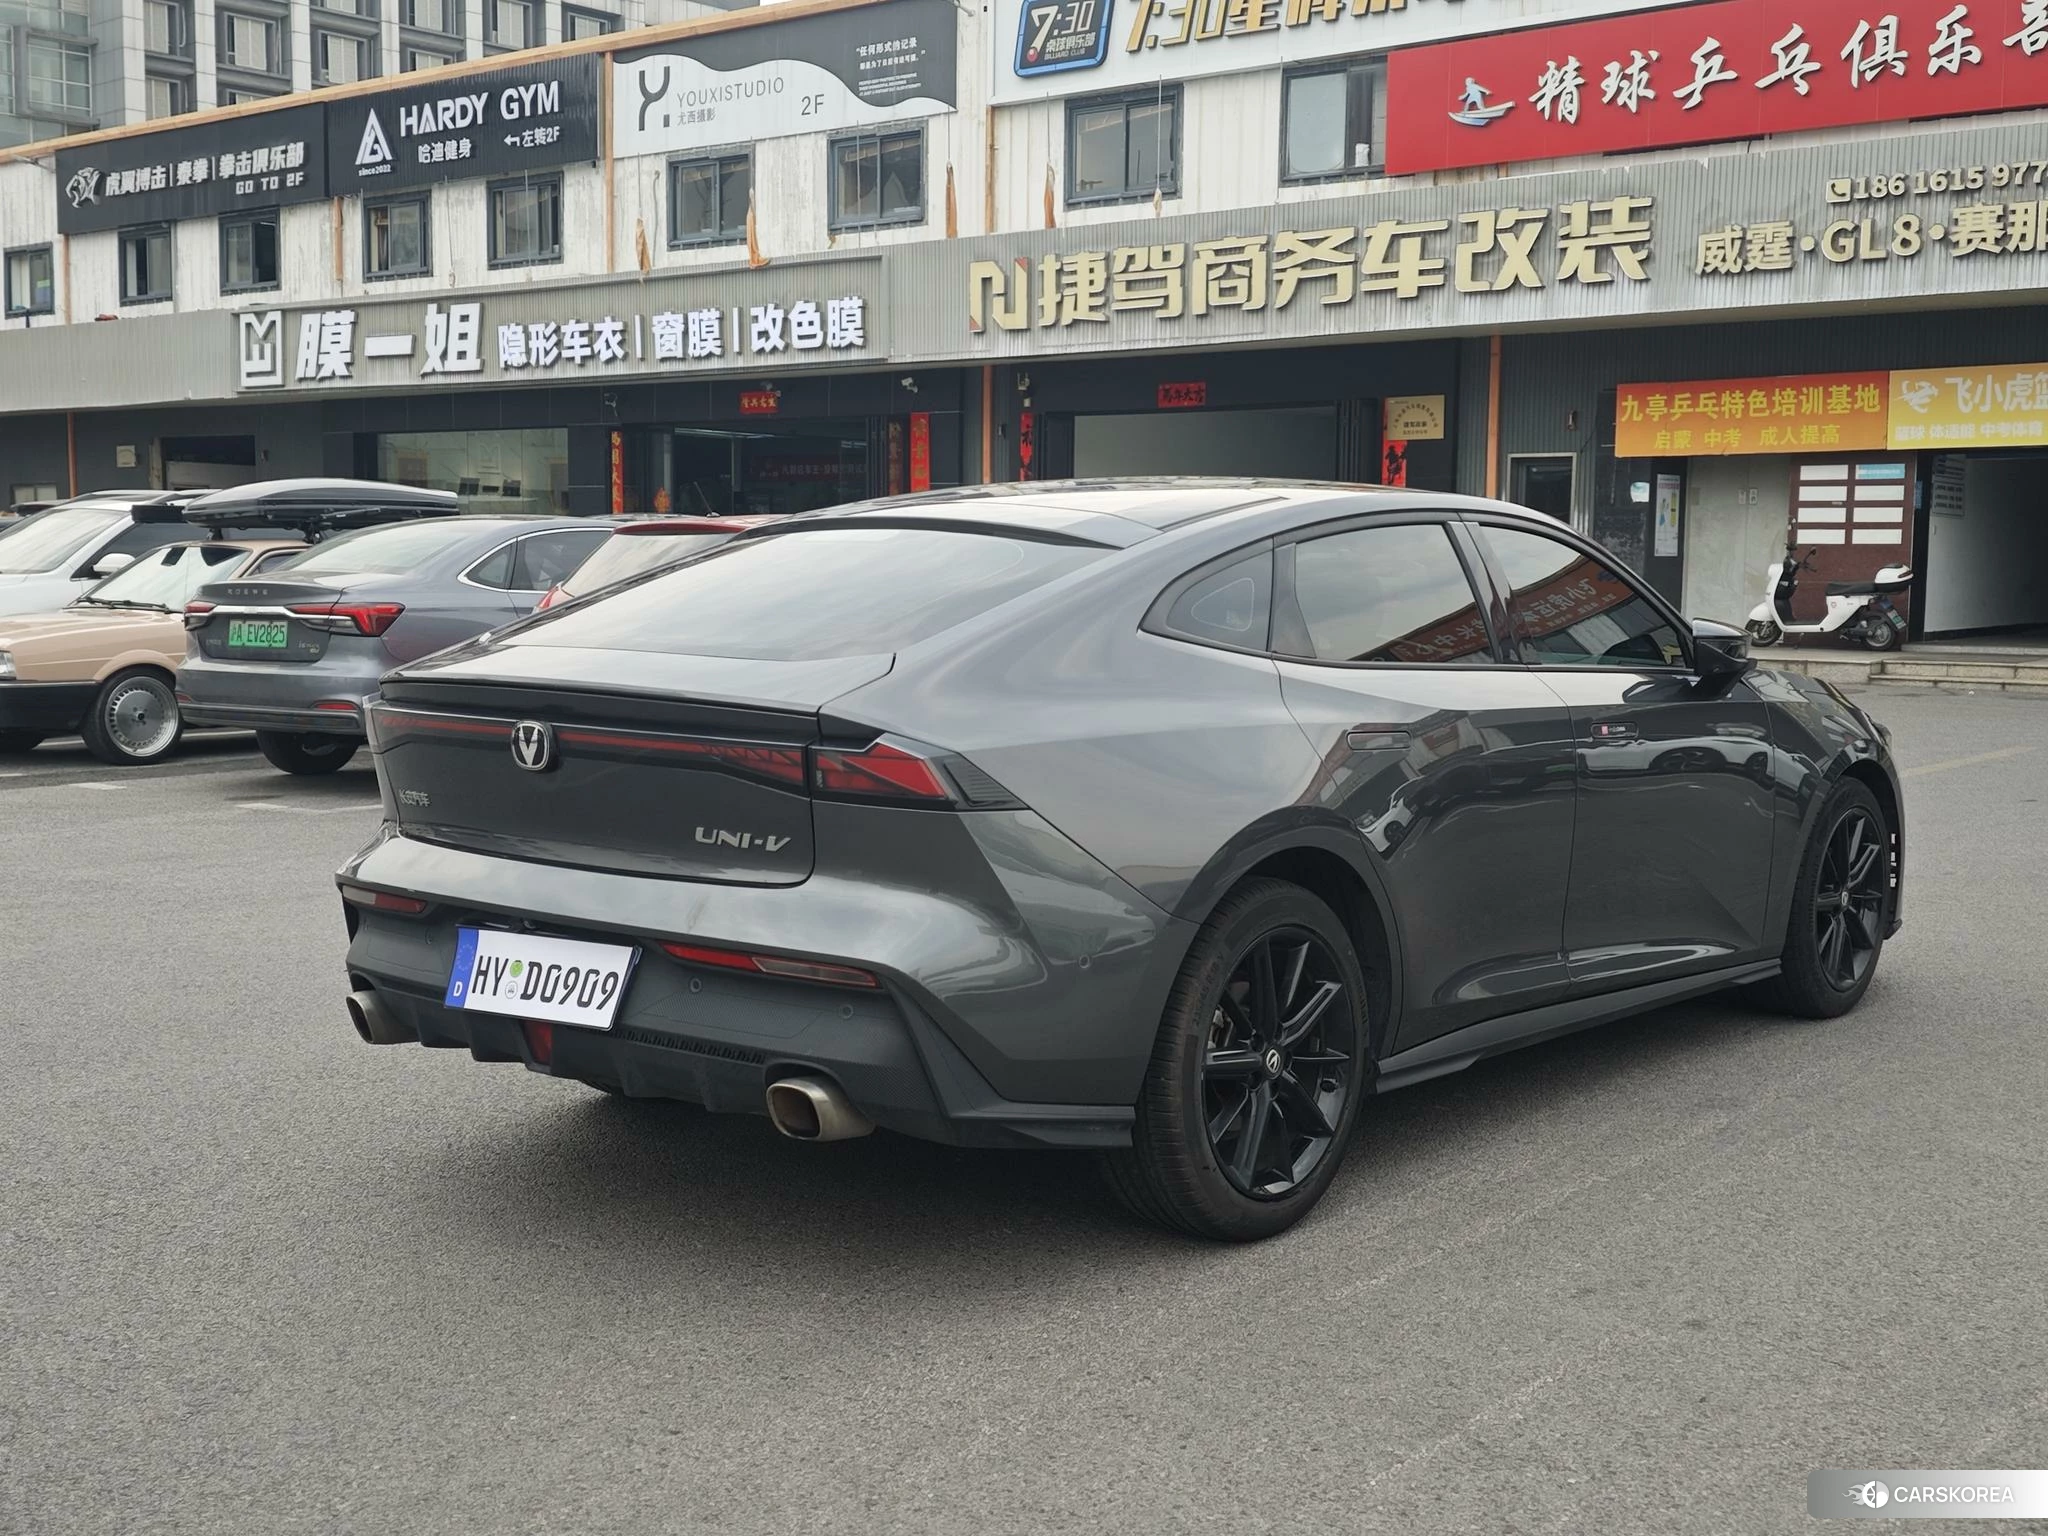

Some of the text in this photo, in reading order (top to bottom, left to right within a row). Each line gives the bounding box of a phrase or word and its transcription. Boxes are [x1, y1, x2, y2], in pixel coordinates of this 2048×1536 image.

[1031, 0, 1095, 52] 7:30
[1044, 47, 1086, 60] BILLIARD CLUB
[1046, 32, 1096, 53] 桌球俱乐部
[676, 76, 785, 108] YOUXISTUDIO
[801, 94, 825, 117] 2F
[400, 80, 560, 137] HARDY GYM
[677, 108, 716, 127] 尤西摄影
[417, 137, 472, 164] 哈迪健身
[522, 126, 560, 148] 左转2F
[105, 141, 305, 197] 虎翼搏击 泰拳 拳击俱乐部
[235, 171, 305, 195] GO TO 2F
[1854, 160, 2048, 199] 186 1615 977
[1037, 195, 1656, 325] 捷驾商务车改装
[295, 302, 484, 380] 膜一姐
[497, 295, 868, 368] 隐形车衣 窗膜 改色膜
[1620, 383, 1881, 423] 九亭乒乓特色培训基地
[1653, 423, 1841, 449] 启蒙 中考 成人提高
[1980, 421, 2043, 437] 中考体育
[695, 826, 792, 852] UNI-V
[453, 981, 463, 997] D
[471, 955, 509, 996] HY
